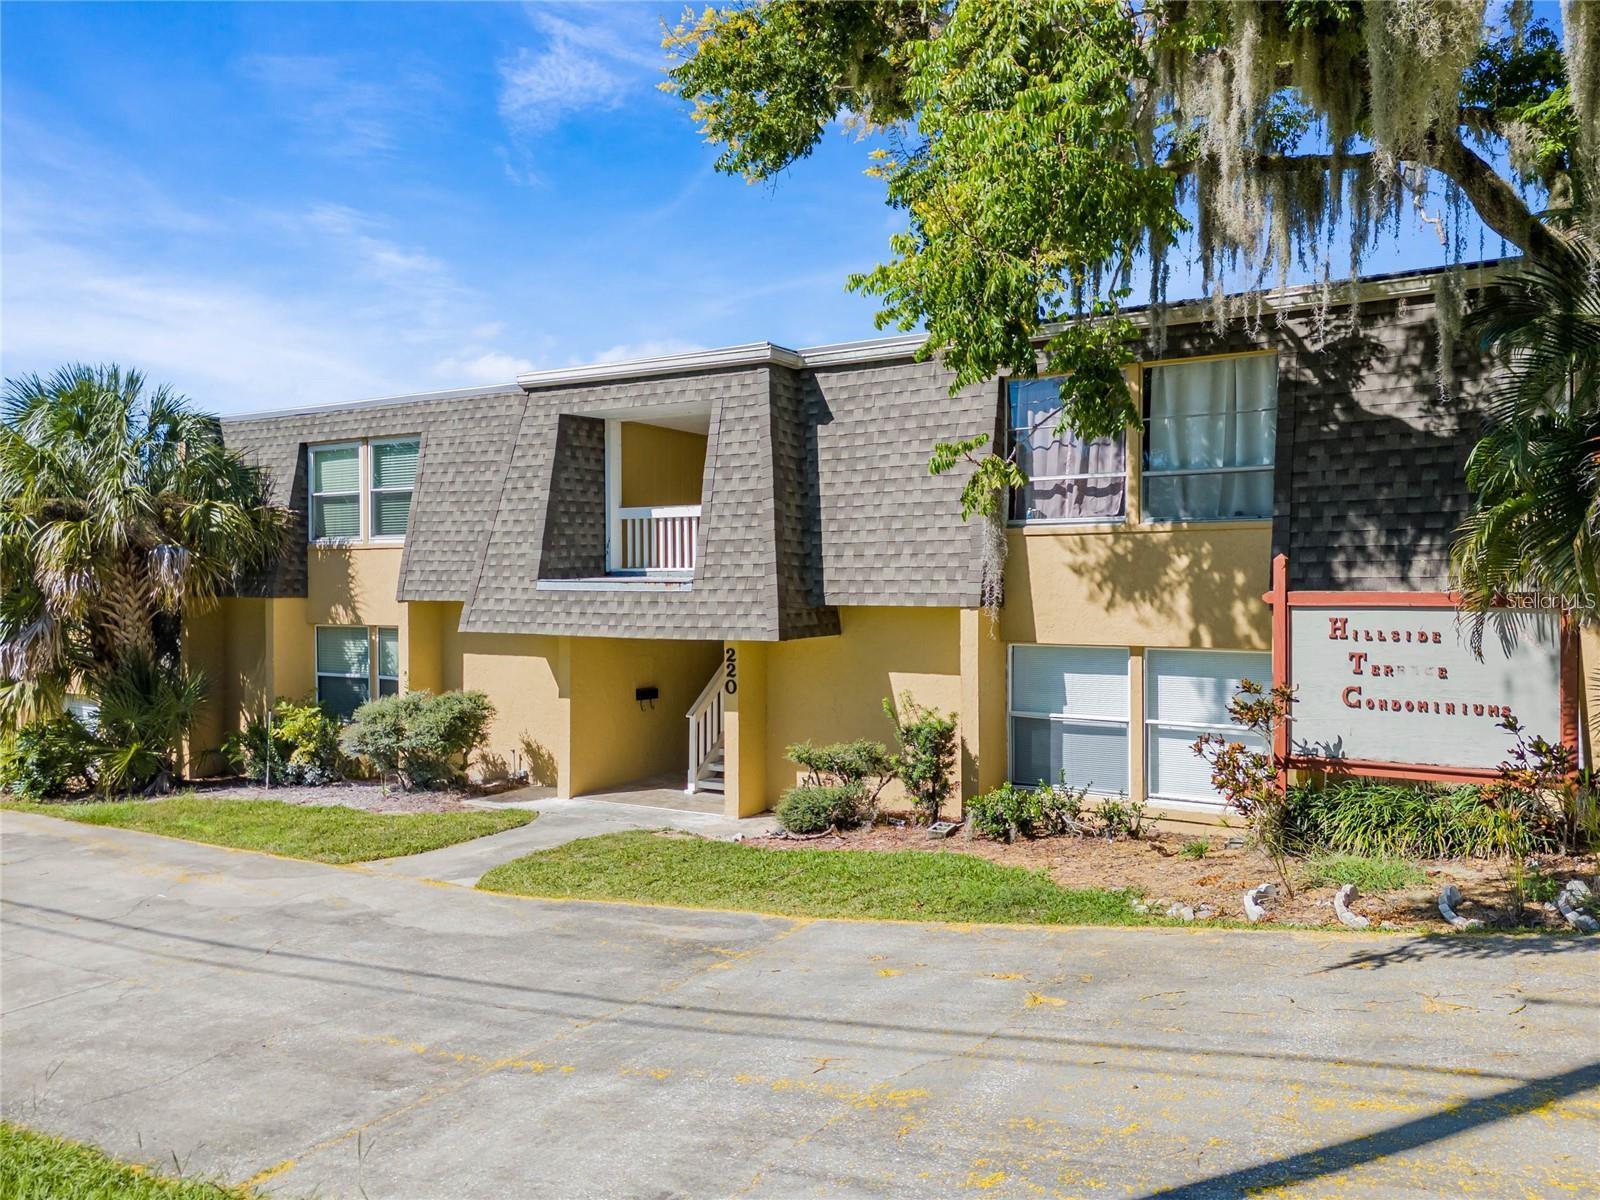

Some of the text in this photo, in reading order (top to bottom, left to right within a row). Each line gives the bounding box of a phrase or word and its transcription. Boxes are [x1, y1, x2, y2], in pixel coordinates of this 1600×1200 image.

[1328, 616, 1442, 644] HILLSIDE
[725, 647, 737, 695] 220
[1341, 685, 1512, 718] CONDOMINIUMS
